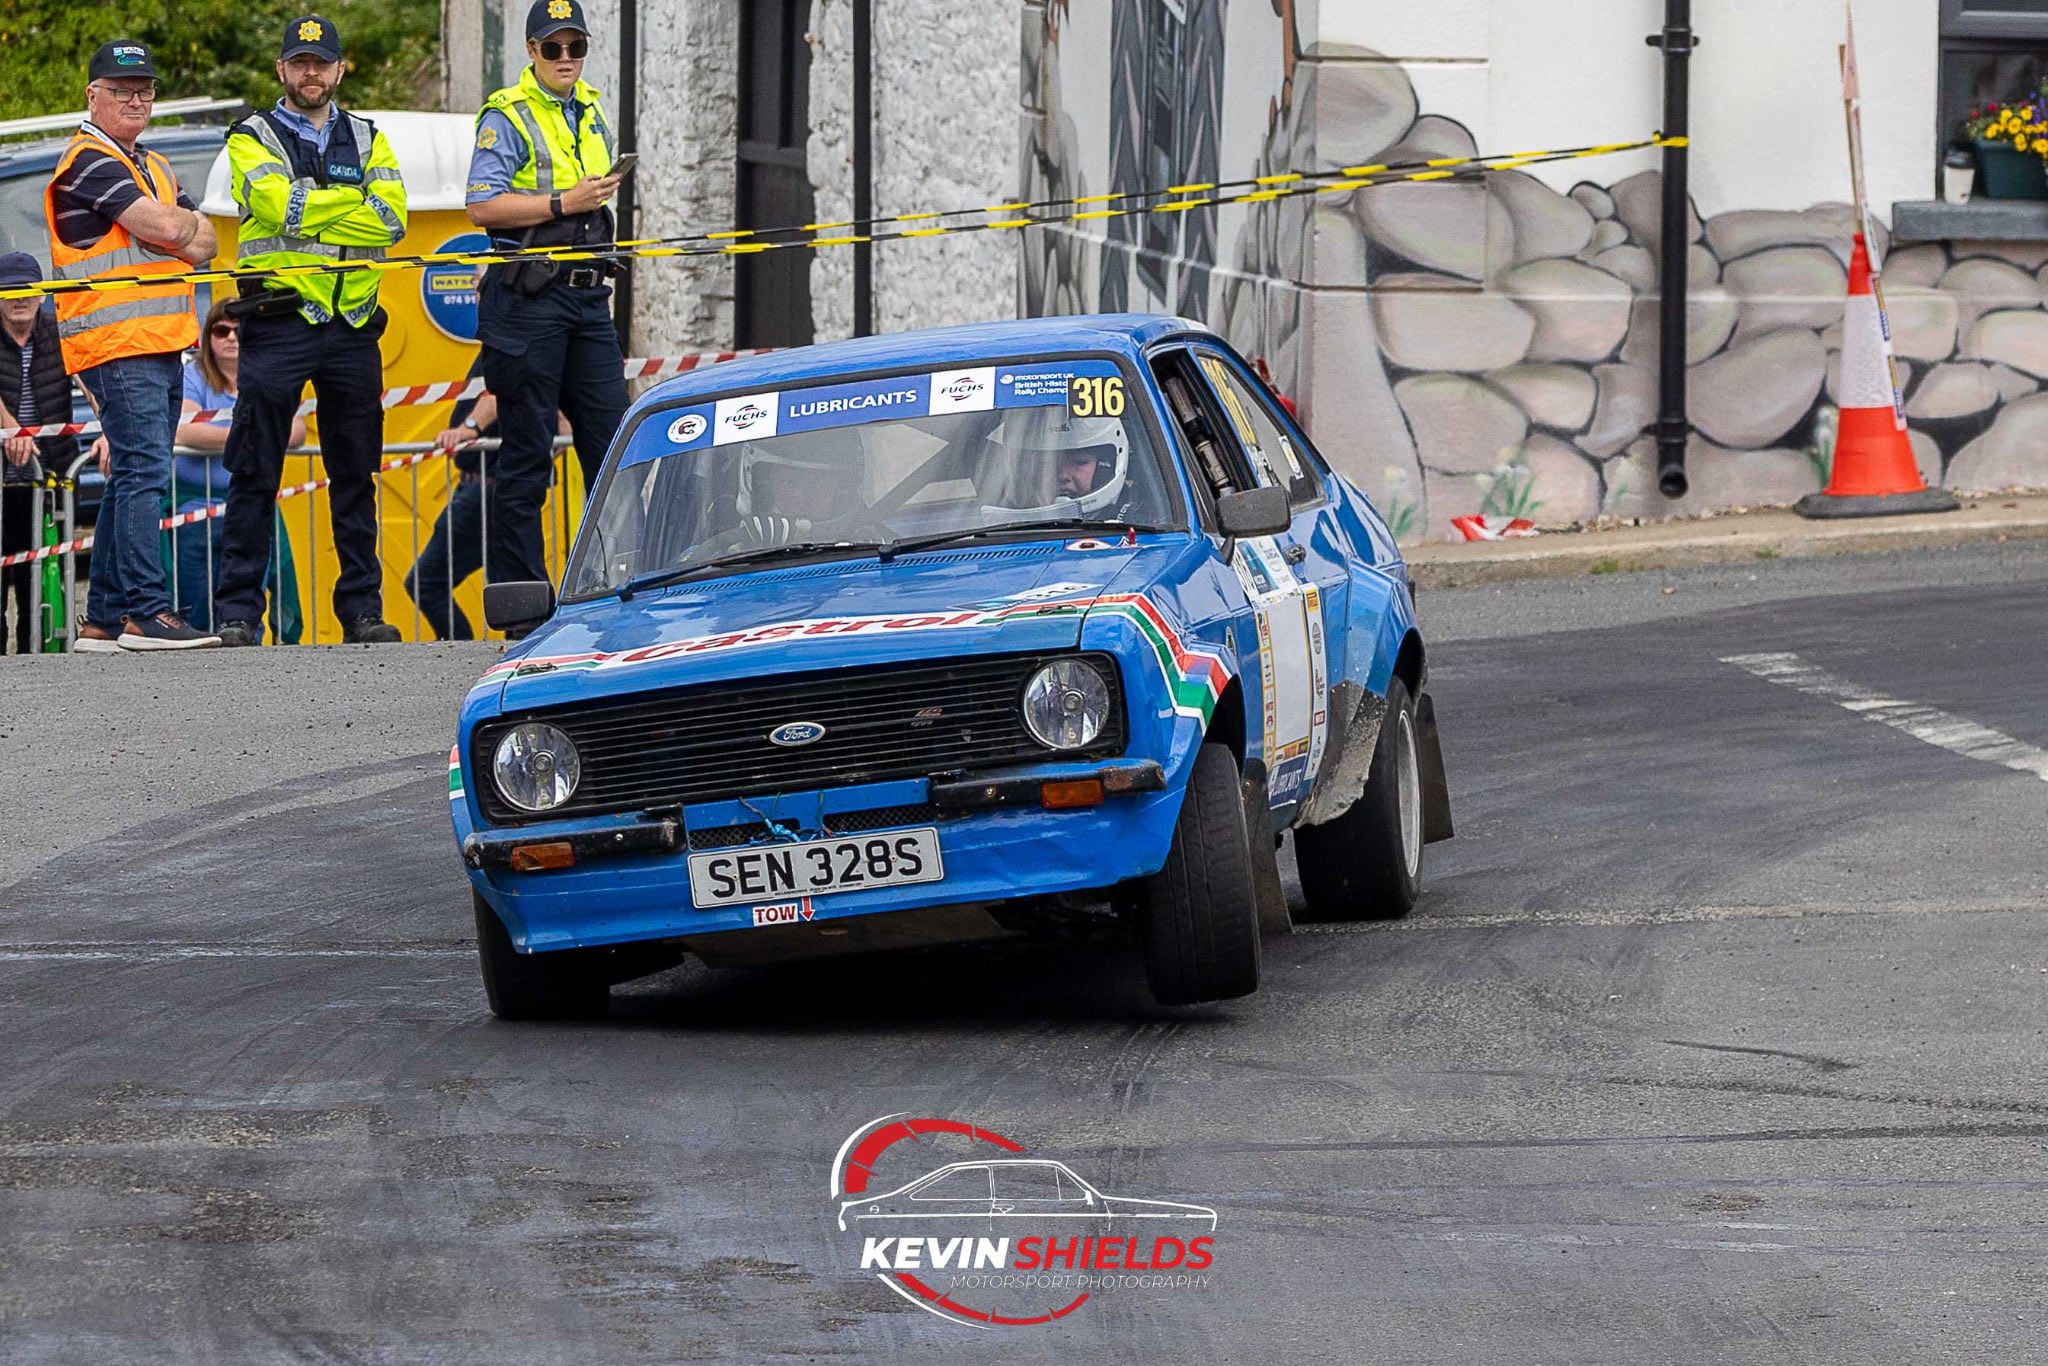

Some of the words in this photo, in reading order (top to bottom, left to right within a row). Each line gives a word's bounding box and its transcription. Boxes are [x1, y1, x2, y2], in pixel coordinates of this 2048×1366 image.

[329, 164, 359, 178] GARDA
[464, 294, 477, 304] 91
[940, 383, 985, 394] FUCHS
[1014, 381, 1043, 389] British
[1044, 380, 1068, 388] Histo
[1014, 388, 1036, 396] Rally
[1037, 387, 1068, 395] Champ
[788, 390, 917, 418] LUBRICANTS
[1072, 377, 1125, 417] 316
[725, 410, 767, 424] FUCHS
[623, 612, 979, 663] Castrol
[783, 726, 812, 741] Ford
[708, 850, 796, 898] SEN
[806, 837, 923, 887] 328S
[755, 905, 797, 923] TOW
